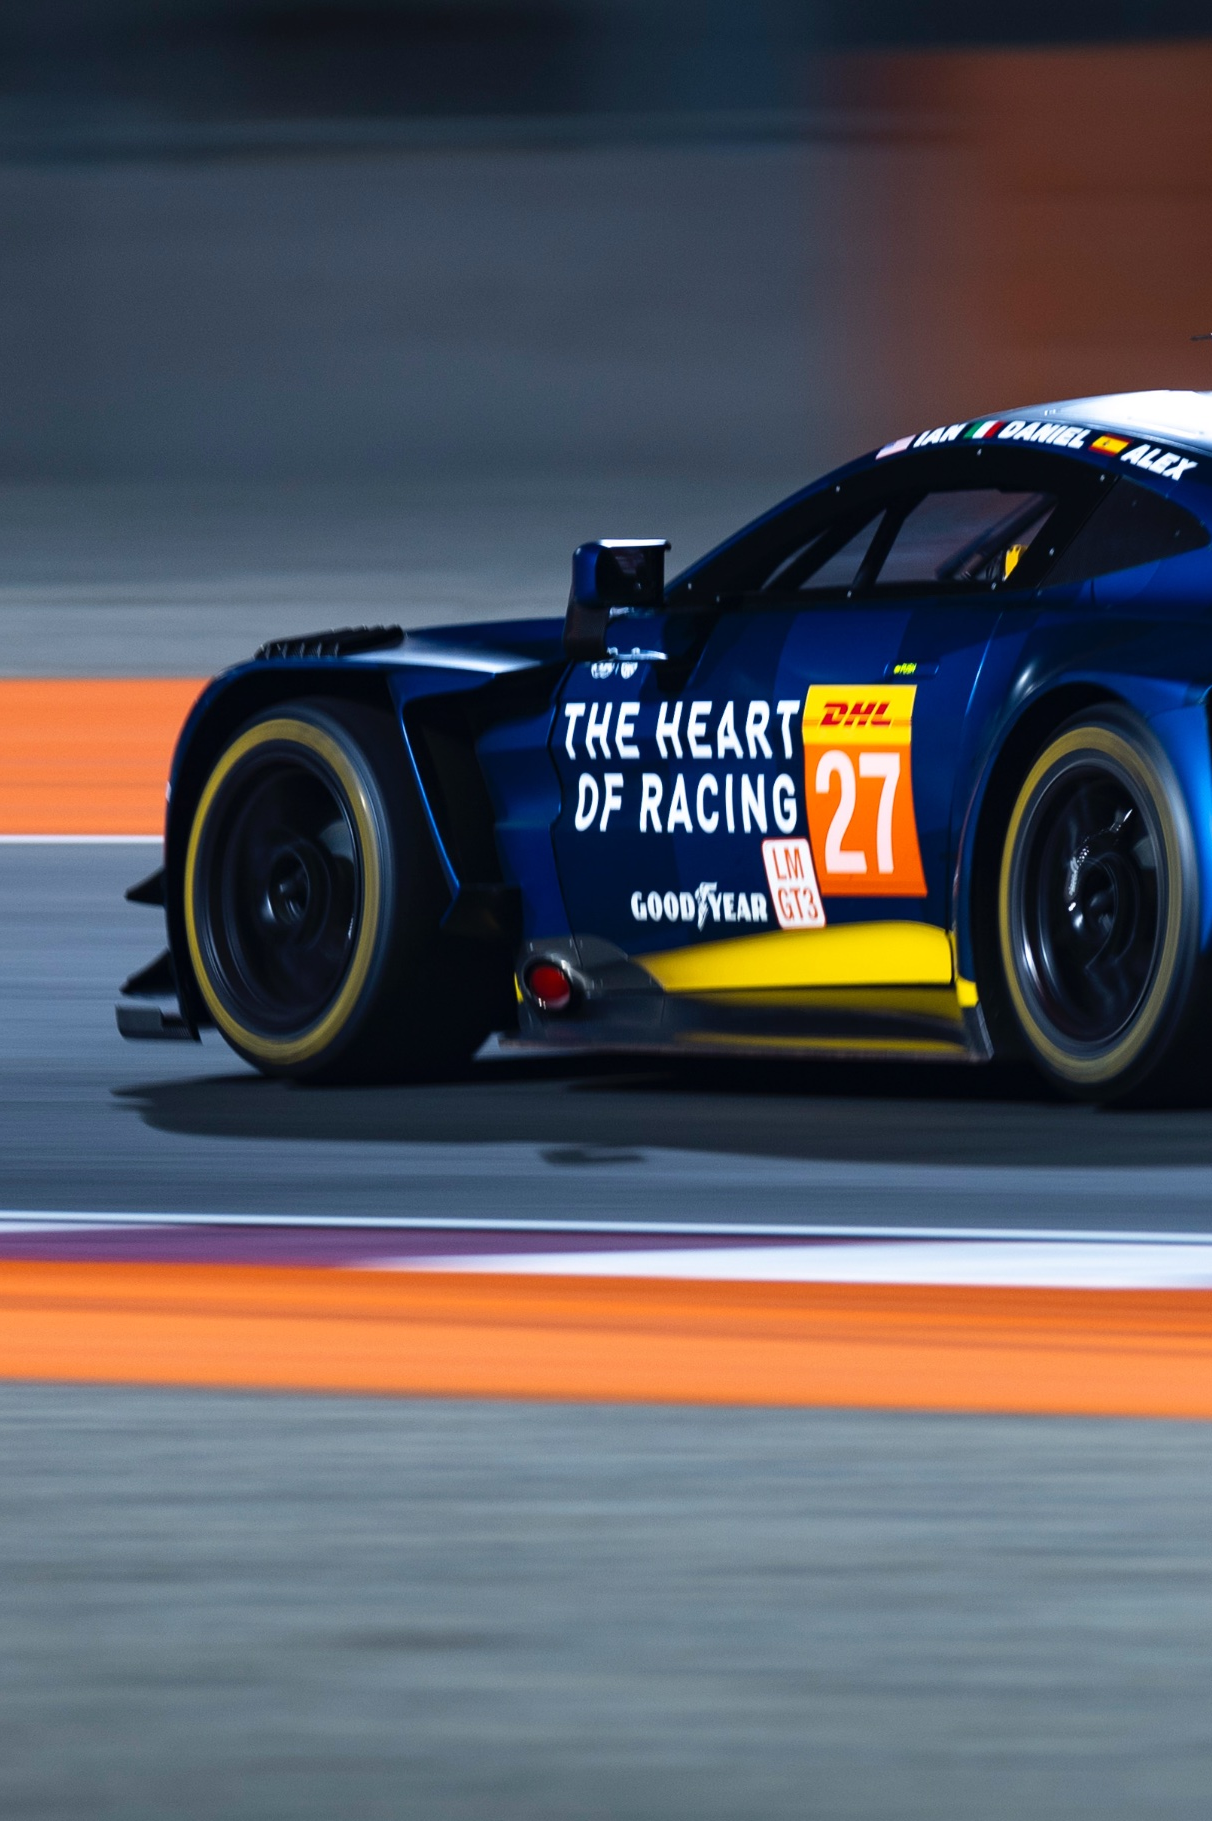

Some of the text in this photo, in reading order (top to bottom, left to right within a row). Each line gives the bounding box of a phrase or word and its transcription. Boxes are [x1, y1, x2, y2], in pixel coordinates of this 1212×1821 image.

[913, 420, 1198, 481] IAN DANIEL ALEX
[564, 699, 803, 760] THE HEART
[820, 702, 893, 727] DHL
[574, 772, 799, 834] OF RACING
[815, 750, 901, 875] 27
[772, 846, 805, 880] LM
[630, 882, 768, 930] GOODYEAR
[777, 887, 819, 921] GT3
